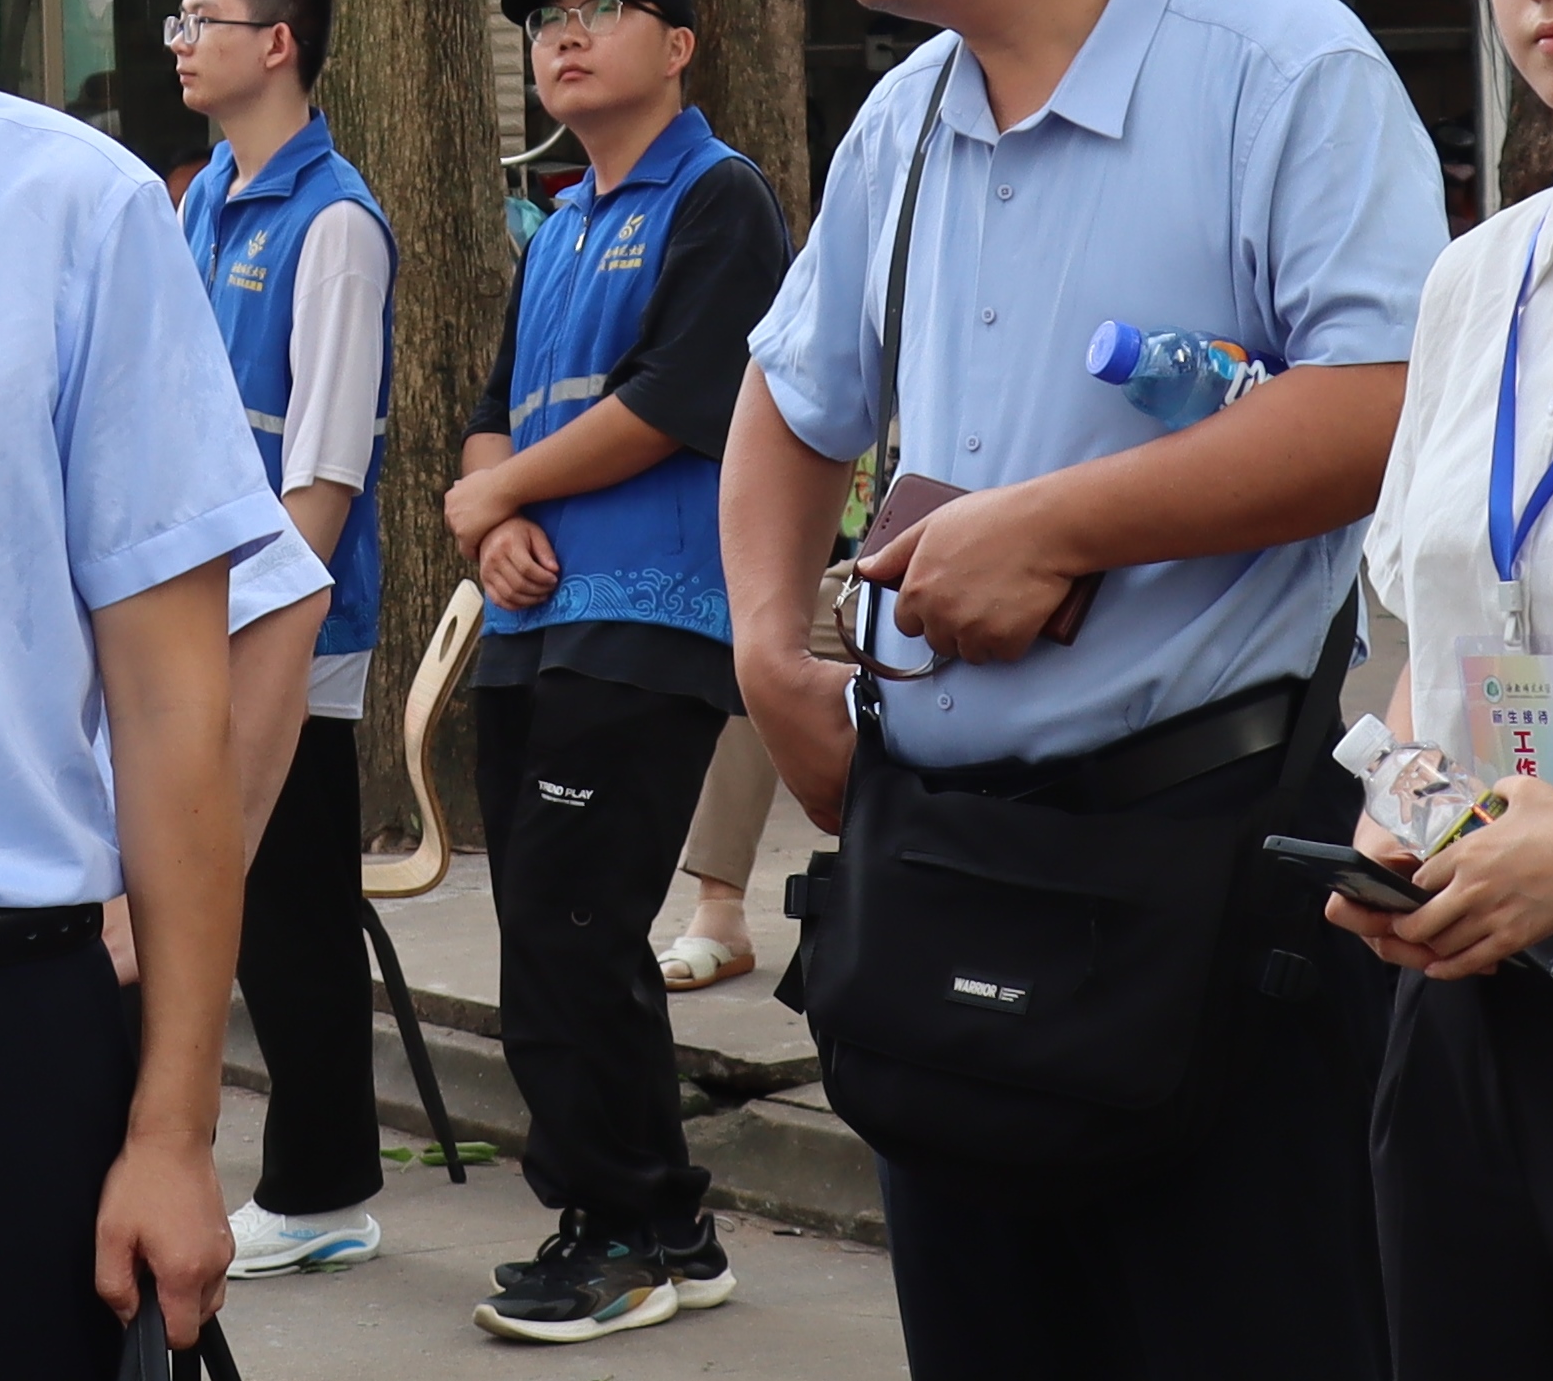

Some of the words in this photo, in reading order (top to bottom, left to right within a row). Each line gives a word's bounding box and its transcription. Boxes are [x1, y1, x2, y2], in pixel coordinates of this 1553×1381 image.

[1492, 709, 1548, 725] 新生接待
[565, 787, 594, 800] PLAY
[954, 977, 998, 999] WARRIOR
